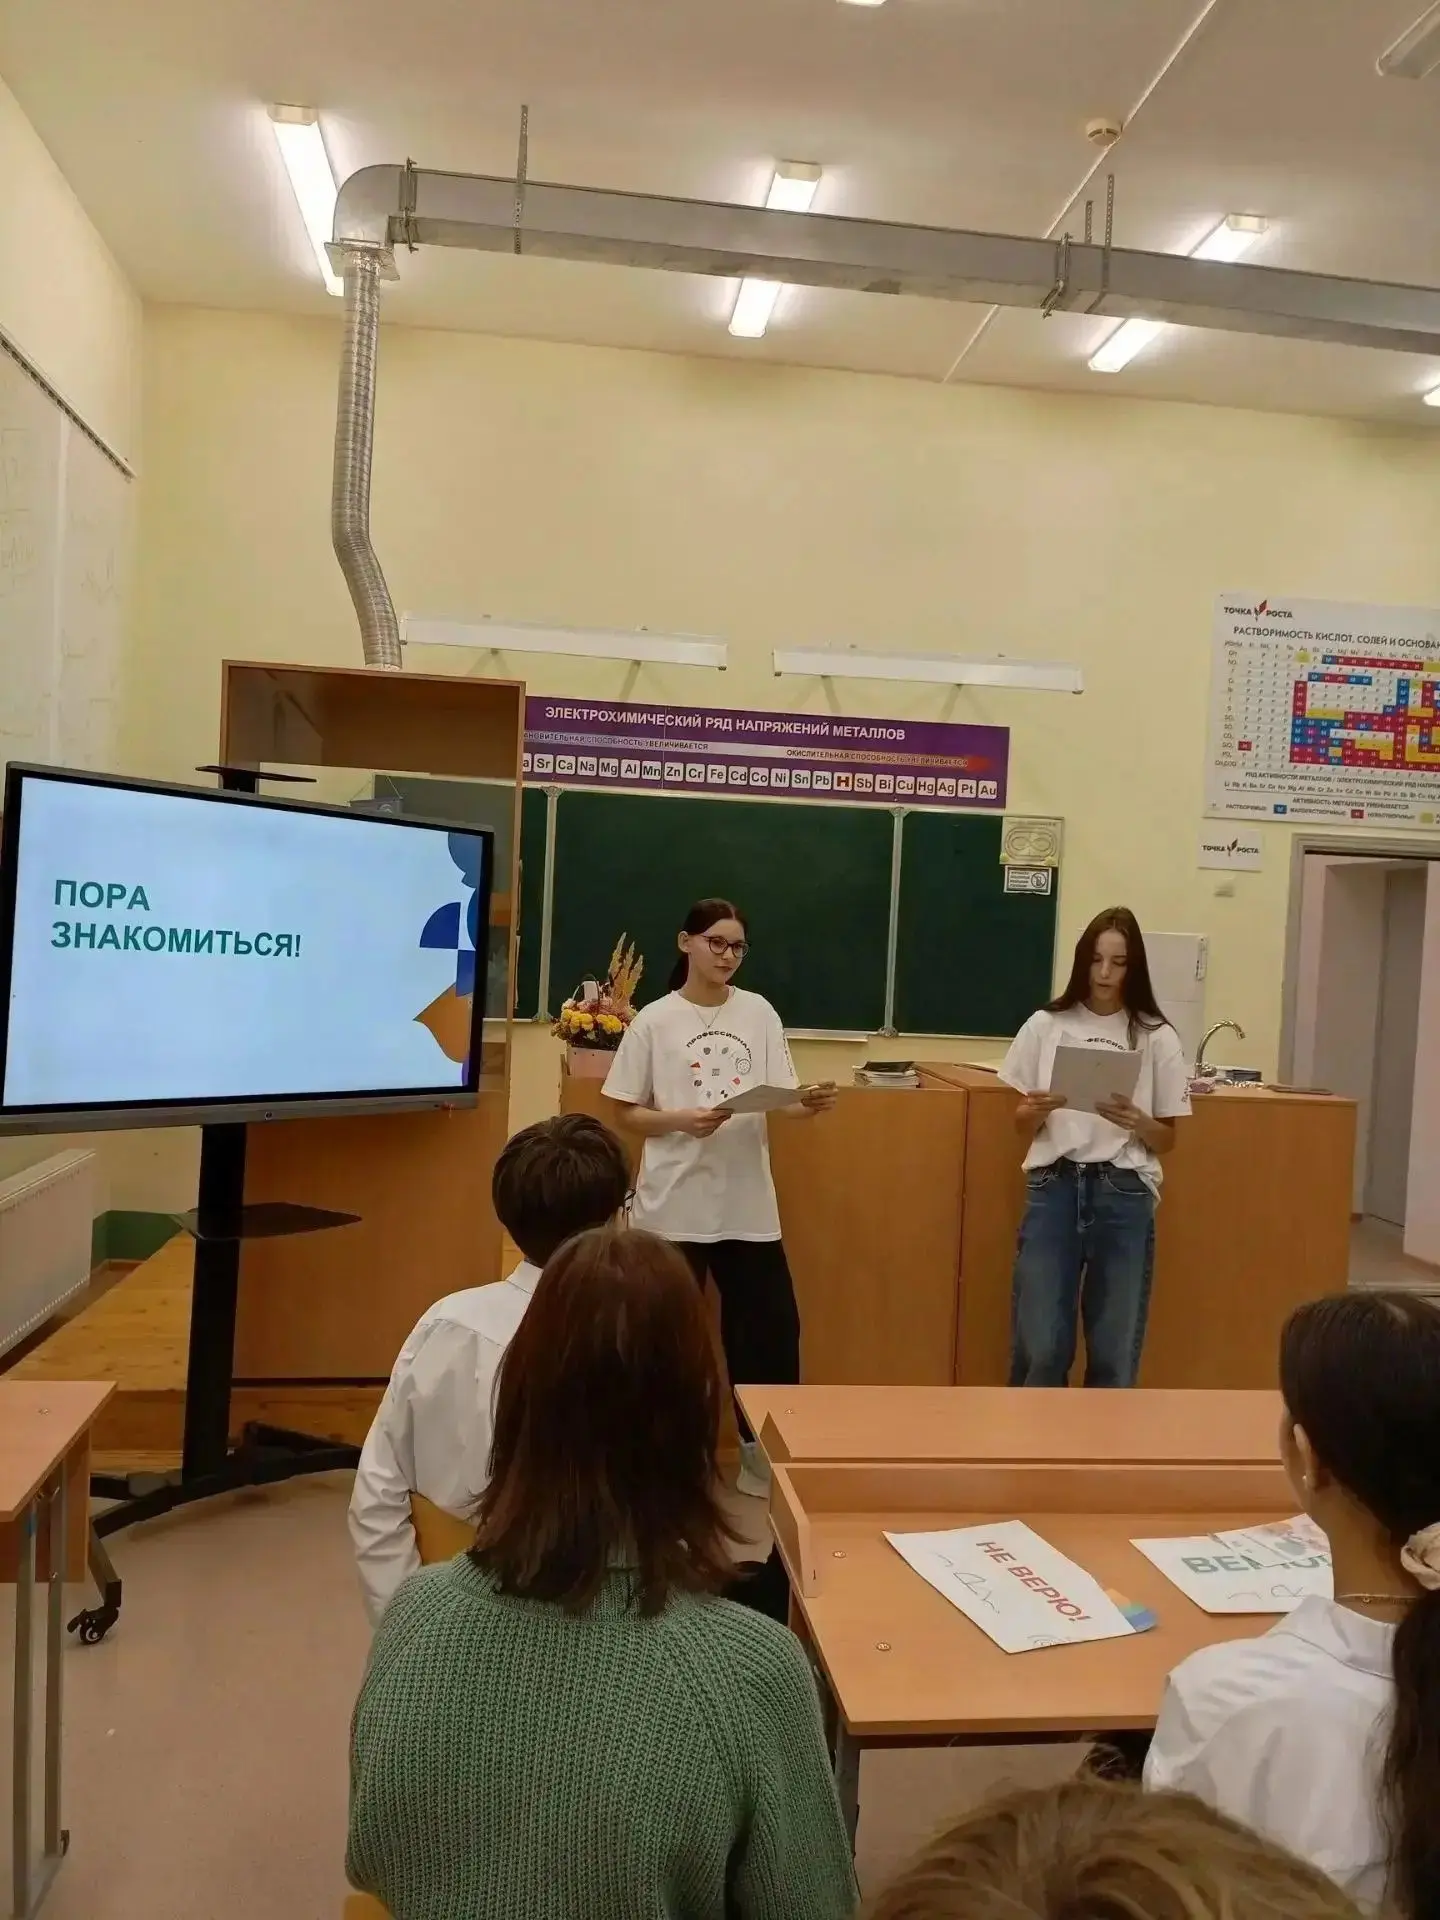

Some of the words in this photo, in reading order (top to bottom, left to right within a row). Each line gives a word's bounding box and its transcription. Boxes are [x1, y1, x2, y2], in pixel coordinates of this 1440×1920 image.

[1224, 606, 1252, 616] ТОЧКА
[1266, 610, 1292, 618] РОСТА
[1233, 626, 1314, 640] РАСТВОРИМОСТЬ
[1357, 635, 1387, 646] СОЛЕЙ
[545, 706, 702, 728] ЭЛЕКТРОХИМИЧЕСКИЙ
[705, 717, 732, 732] РЯД
[736, 719, 829, 736] НАПРЯЖЕНИЙ
[832, 726, 906, 740] МЕТАЛЛОВ
[588, 737, 642, 746] СПОСОБНОСТЬ
[645, 740, 708, 750] УВЕЛИЧИВАЕТСЯ
[786, 750, 849, 759] ОКИСЛИТЕЛЬНАЯ
[536, 759, 550, 768] Sr
[558, 760, 573, 770] Ca
[580, 761, 594, 772] Na
[601, 762, 617, 775] Mg
[625, 764, 636, 774] Al
[644, 766, 660, 776] Mn
[666, 766, 680, 776] Zn
[688, 768, 702, 778] Cr
[711, 769, 724, 779] Fe
[730, 770, 746, 781] Cd
[752, 772, 768, 782] Co
[775, 772, 786, 783] Ni
[794, 774, 808, 784] Sn
[816, 775, 830, 785] Pb
[836, 776, 849, 787] H
[856, 778, 872, 788] Sb
[880, 780, 890, 790] Bi
[898, 780, 913, 790] Cu
[918, 782, 934, 793] Hg
[939, 782, 954, 794] Ag
[962, 784, 974, 794] Pt
[980, 785, 996, 796] Au
[54, 880, 150, 911] ПОРА
[50, 922, 300, 957] ЗНАКОМИТЬСЯ!
[976, 1542, 1017, 1564] НЕ
[1008, 1566, 1092, 1622] ВЕРЮ!
